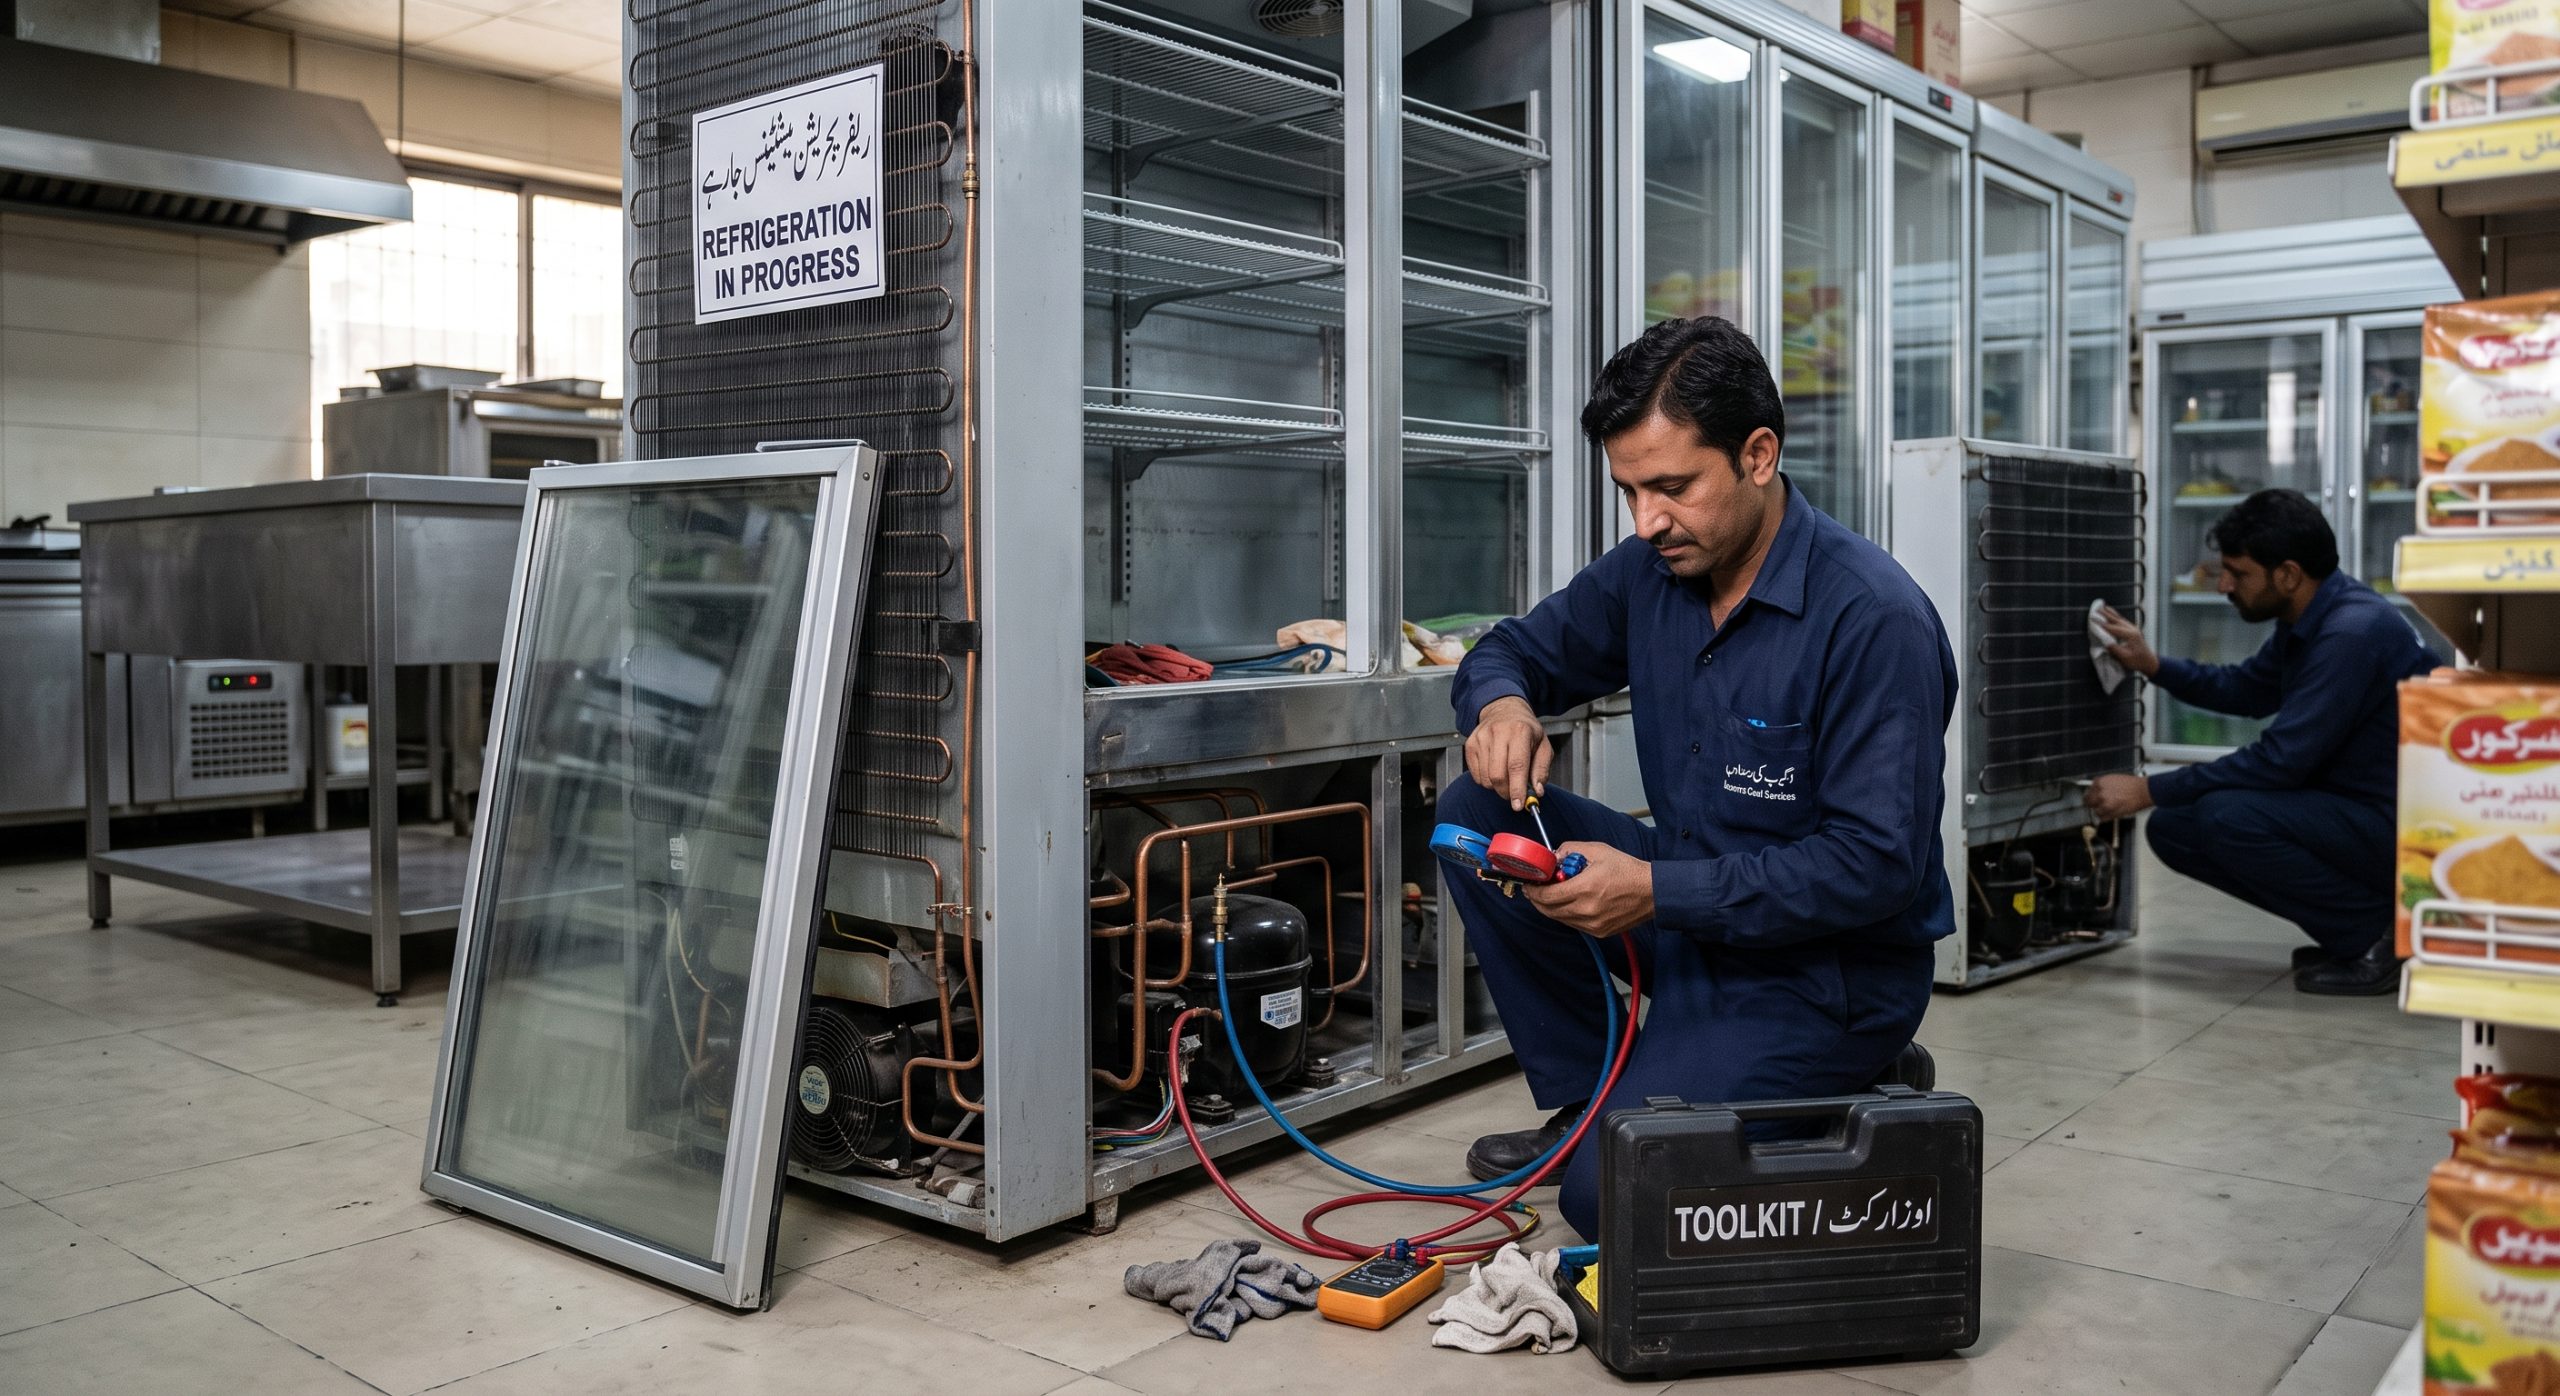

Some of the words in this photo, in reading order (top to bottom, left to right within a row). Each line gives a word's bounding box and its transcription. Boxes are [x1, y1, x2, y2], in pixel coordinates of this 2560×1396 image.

[703, 196, 872, 260] REFRIGERATION
[715, 267, 735, 299] IN
[741, 244, 860, 295] PROGRESS
[1675, 1201, 1806, 1242] TOOLKIT
[1812, 1199, 1823, 1235] /
[1874, 1196, 1932, 1232] اوزار
